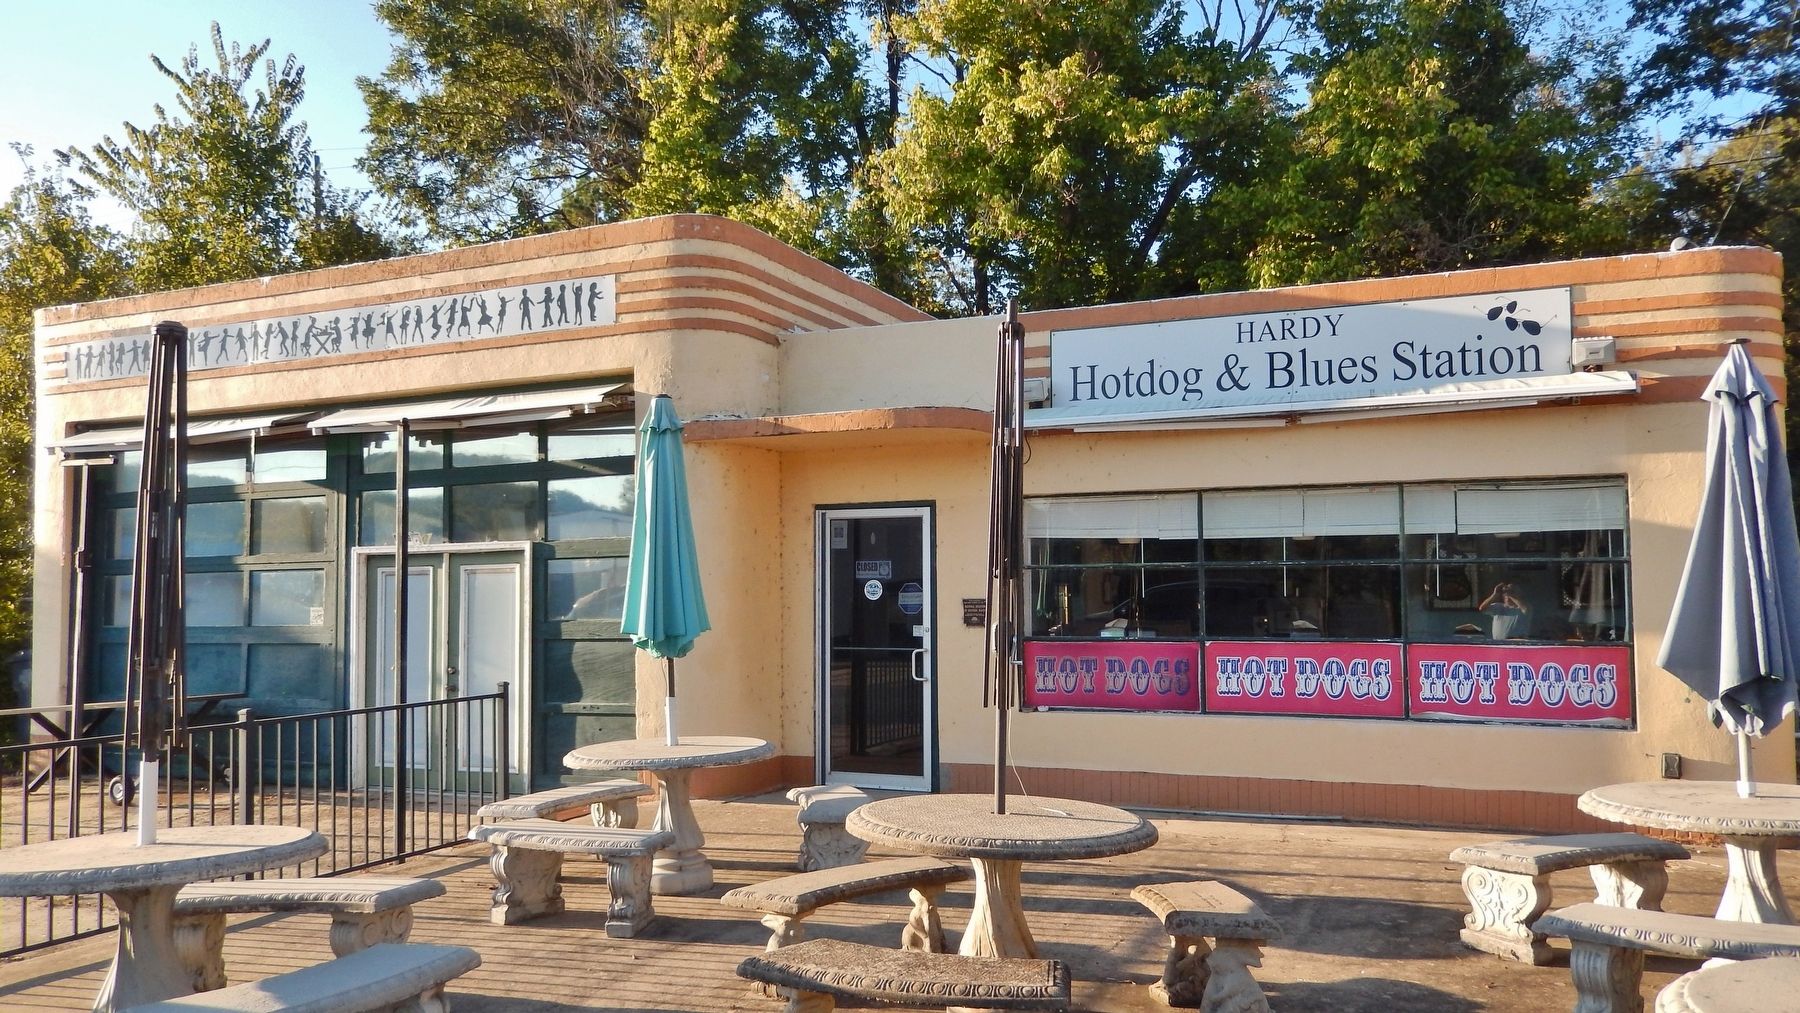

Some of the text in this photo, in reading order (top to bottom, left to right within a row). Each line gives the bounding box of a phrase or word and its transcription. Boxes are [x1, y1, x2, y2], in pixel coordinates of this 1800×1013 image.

[1236, 313, 1344, 343] HARDY
[1069, 334, 1544, 401] Hotdog & Blues Station
[856, 562, 878, 572] CLOSED
[1035, 655, 1191, 697] HOT DOGS
[1216, 656, 1391, 701] HOT DOGS
[1420, 661, 1617, 709] HOT DOGS
